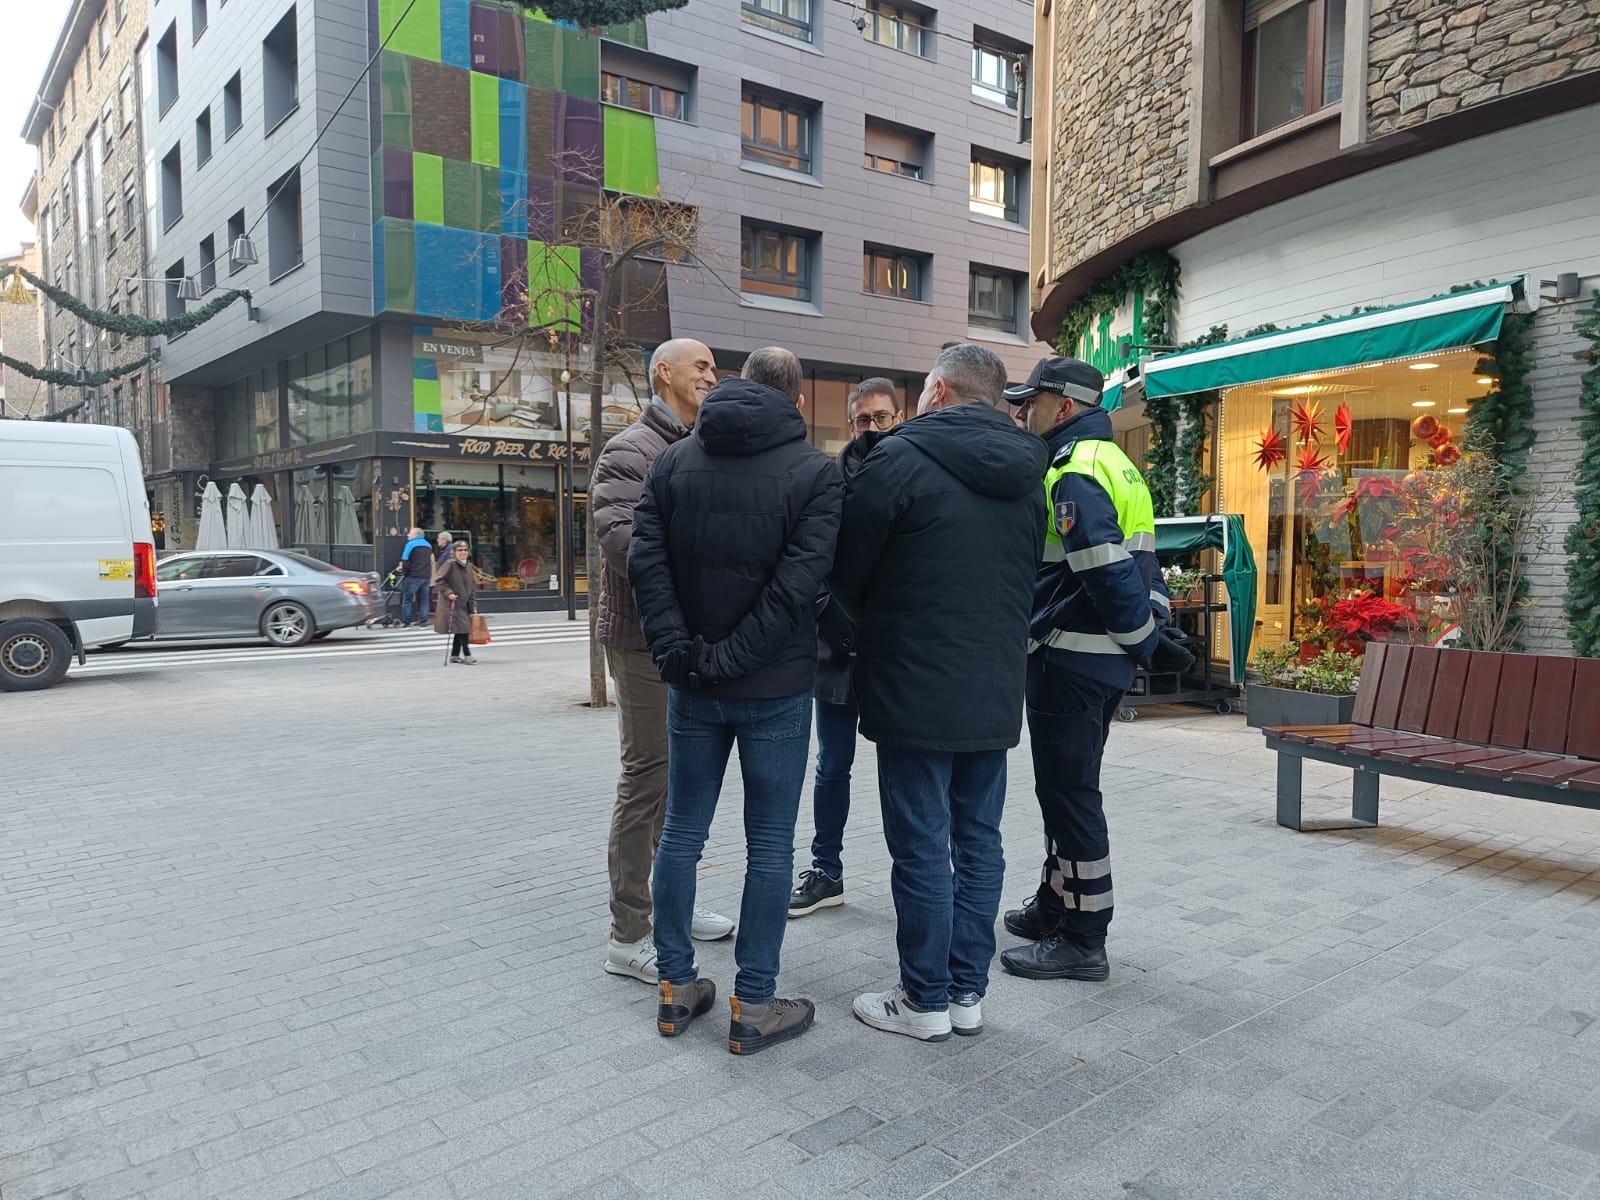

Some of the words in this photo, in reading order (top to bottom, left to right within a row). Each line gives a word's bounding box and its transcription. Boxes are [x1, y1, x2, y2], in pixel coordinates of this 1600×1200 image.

[422, 342, 438, 353] EN
[439, 344, 476, 357] VENDA
[458, 438, 491, 455] FOOD
[493, 440, 527, 458] BEER
[528, 442, 543, 459] &
